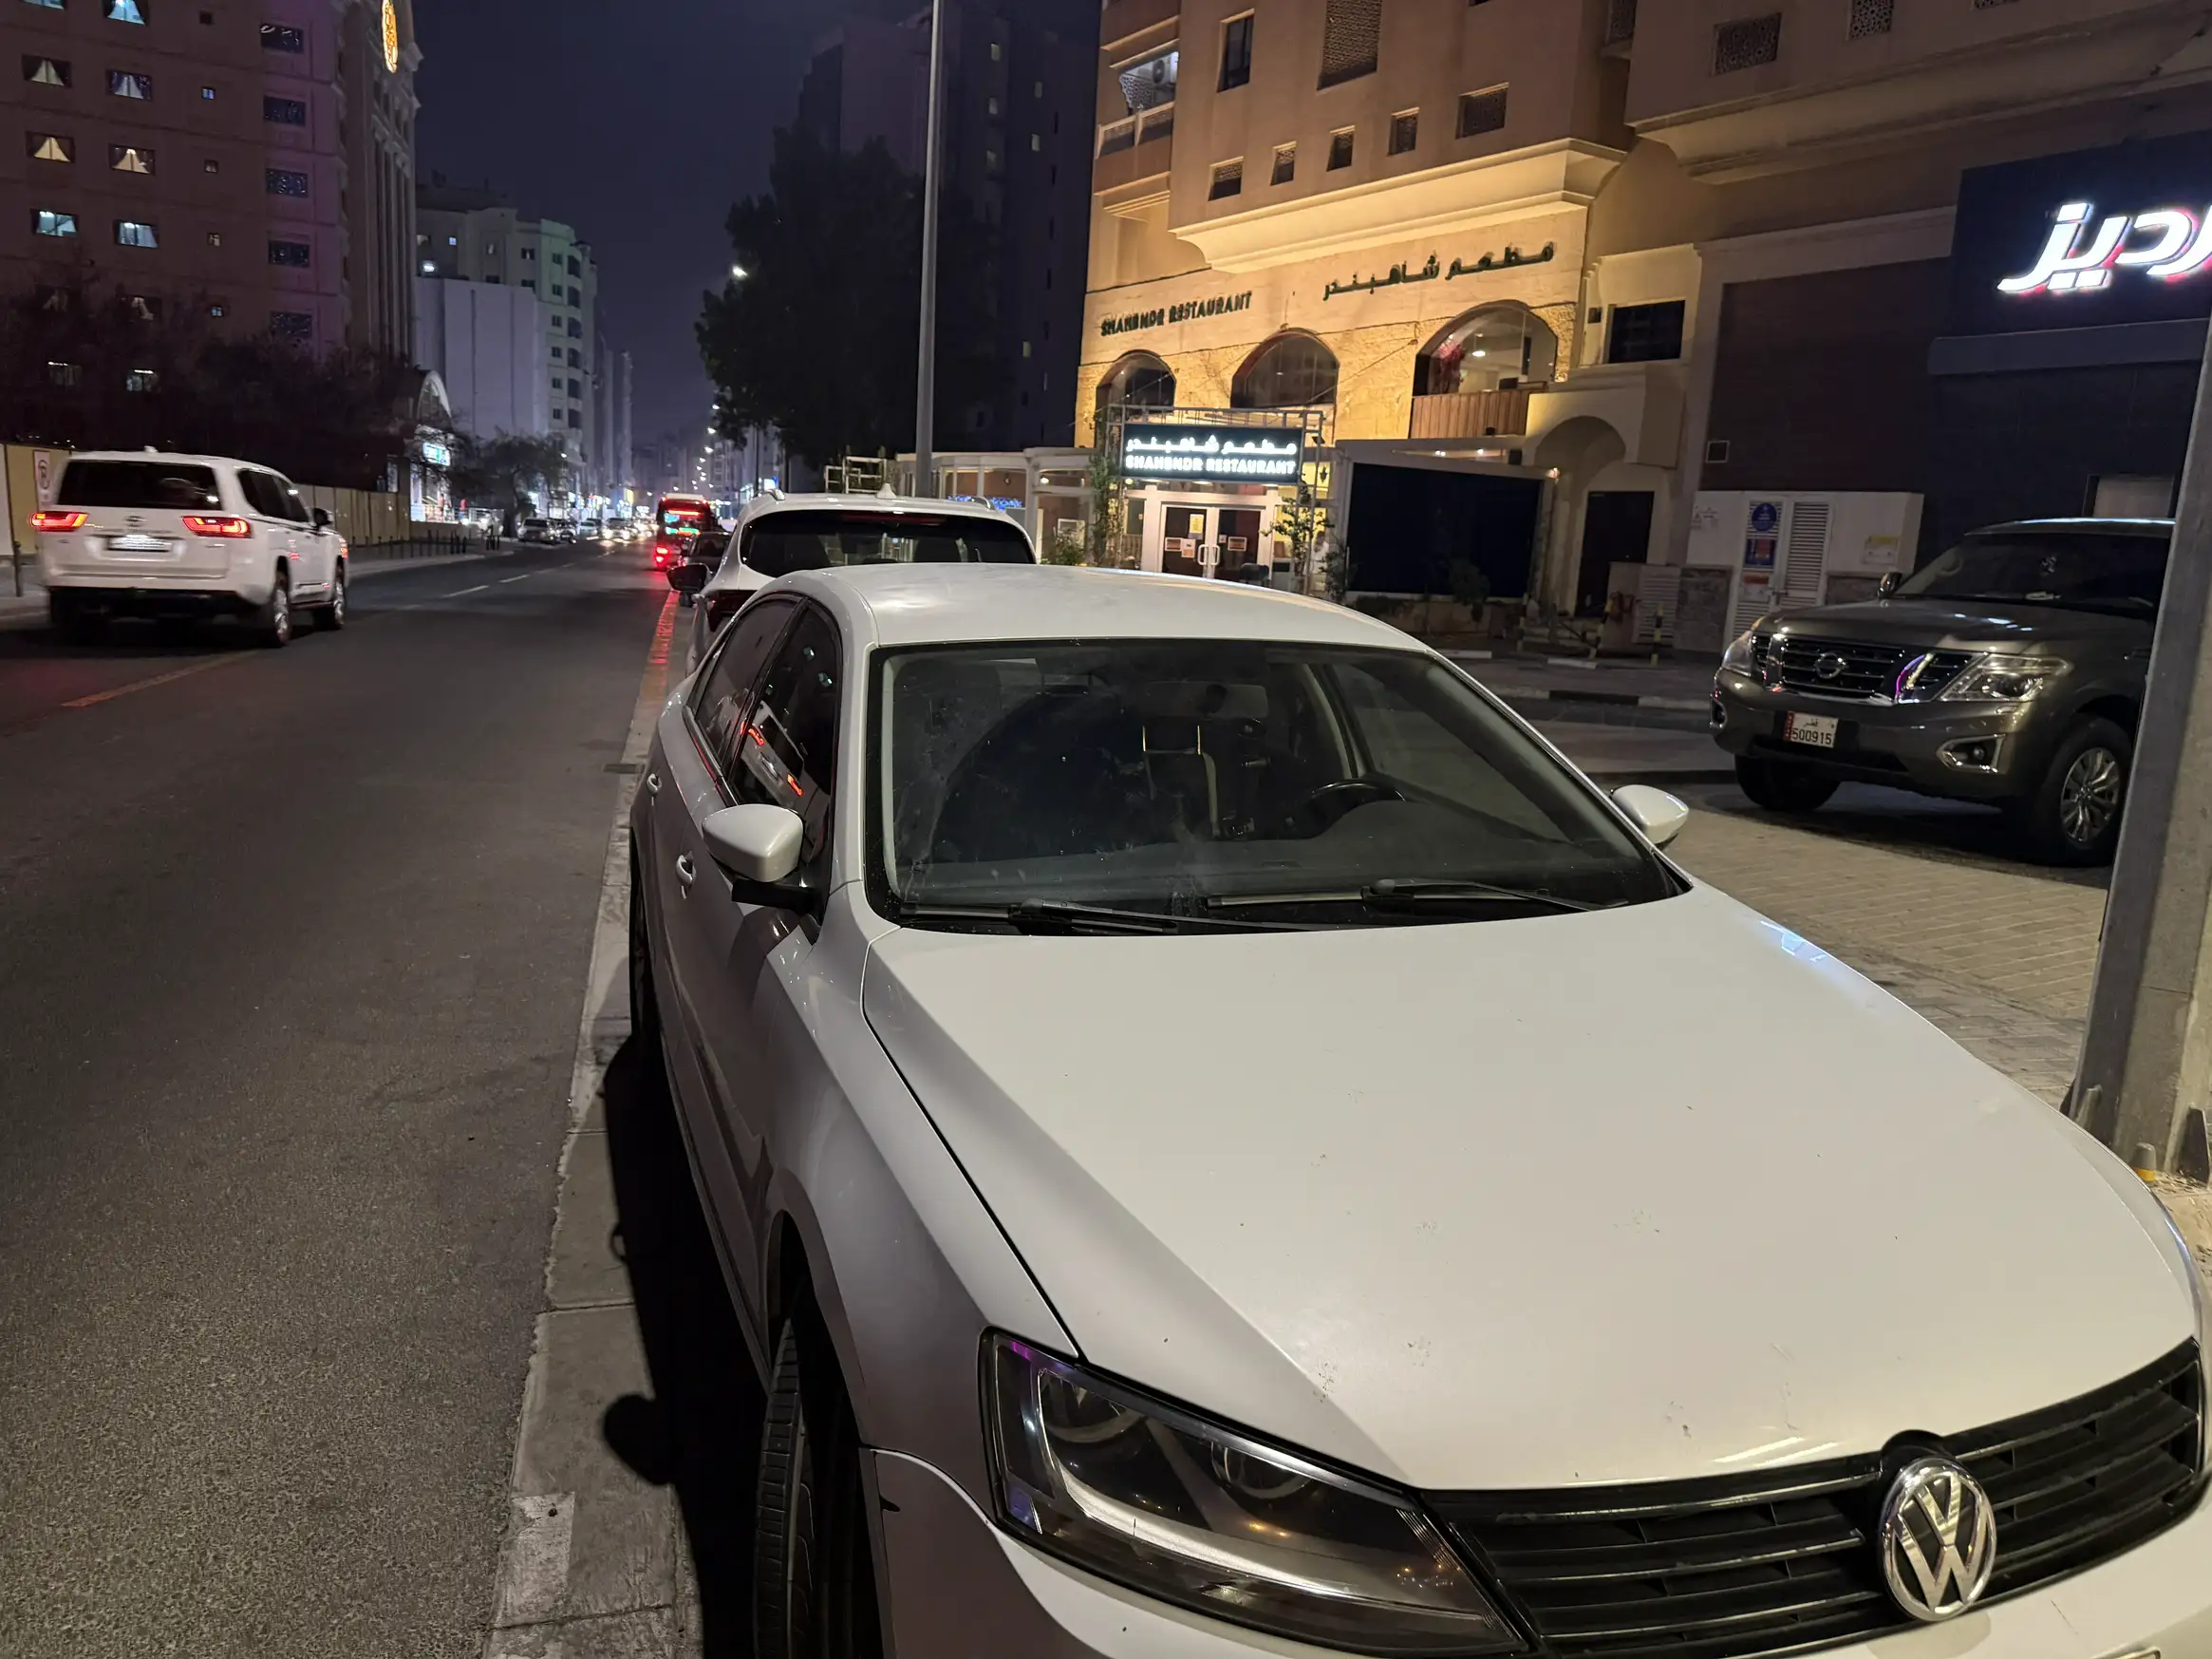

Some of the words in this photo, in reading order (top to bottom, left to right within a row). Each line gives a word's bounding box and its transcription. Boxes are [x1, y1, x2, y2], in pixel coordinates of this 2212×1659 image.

[1445, 241, 1555, 281] مطعم
[1322, 251, 1440, 301] شاهبندر
[1169, 291, 1252, 324] RESTAURANT
[1126, 434, 1220, 454] شاهبندر
[1221, 438, 1298, 456] مطعم
[1206, 458, 1297, 475] RESTAURANT
[1792, 728, 1832, 745] 500915
